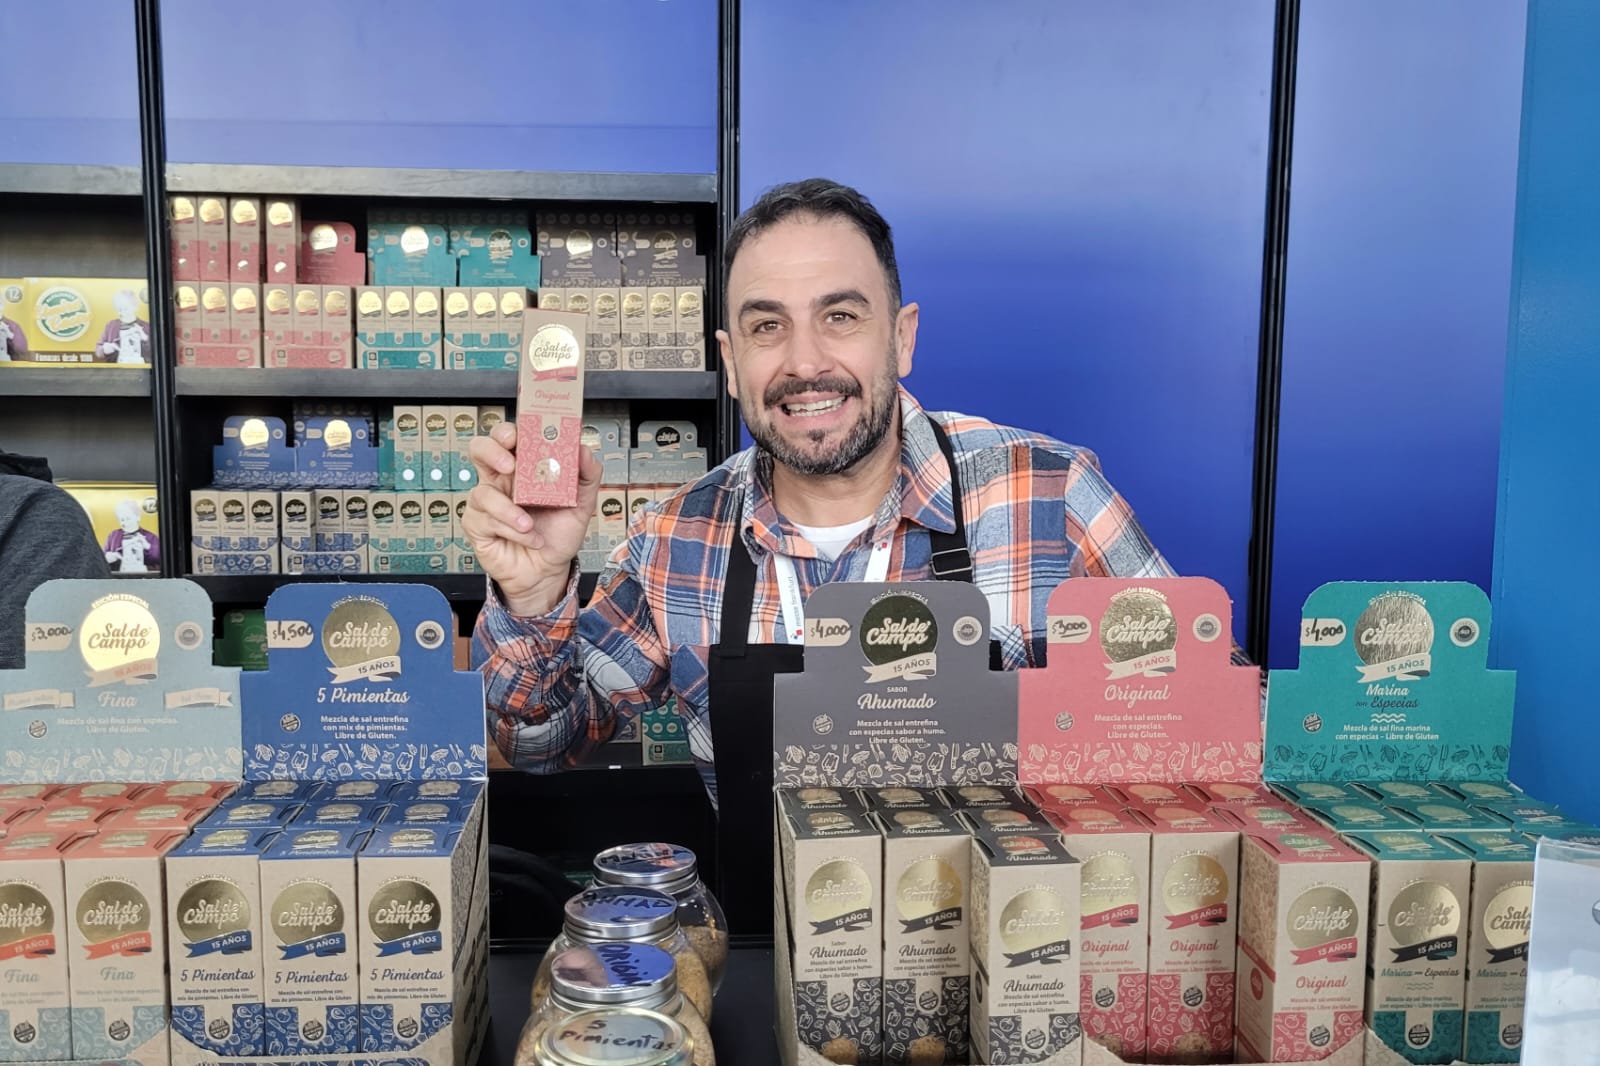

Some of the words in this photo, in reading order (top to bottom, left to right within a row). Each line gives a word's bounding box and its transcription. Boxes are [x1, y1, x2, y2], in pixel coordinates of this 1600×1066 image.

[9, 288, 20, 300] 12
[543, 341, 560, 352] Sal
[561, 343, 573, 352] de
[535, 347, 571, 363] Campo
[1110, 587, 1137, 602] EDICIÓN
[1138, 586, 1169, 602] ESPECIAL
[881, 617, 907, 633] Sal
[907, 617, 929, 632] de
[1121, 615, 1147, 630] Sal
[1147, 615, 1170, 630] de
[1378, 618, 1403, 632] Sal
[103, 623, 129, 638] Sal
[130, 623, 150, 637] de
[344, 622, 368, 638] Sal
[370, 622, 391, 638] de
[1106, 625, 1169, 649] Campo
[88, 633, 149, 656] Campo
[330, 630, 391, 655] Campo
[866, 627, 929, 652] Campo
[1360, 628, 1423, 652] Campo
[358, 666, 367, 674] 15
[368, 659, 395, 672] AÑOS
[894, 664, 902, 672] 15
[904, 658, 931, 670] AÑOS
[1134, 662, 1143, 670] 15
[1144, 656, 1171, 668] AÑOS
[1387, 665, 1396, 673] 15
[1398, 659, 1425, 671] AÑOS
[317, 687, 327, 703] 5
[331, 687, 411, 703] Pimientas
[1104, 684, 1171, 709] Original
[1366, 683, 1409, 697] Marina
[97, 690, 138, 708] Fina
[857, 692, 937, 710] Ahumado
[1371, 696, 1418, 713] Especias
[320, 715, 348, 723] Mezcla
[349, 715, 360, 723] de
[361, 715, 372, 723] sal
[373, 715, 409, 723] entrefina
[857, 719, 882, 727] Mezcla
[883, 719, 893, 727] de
[894, 719, 904, 727] sal
[905, 719, 938, 727] entrefina
[1095, 713, 1121, 721] Mezcla
[1122, 713, 1133, 721] de
[1134, 713, 1146, 721] sal
[1147, 713, 1182, 721] entrefina
[339, 724, 354, 732] mix
[355, 724, 365, 732] de
[366, 724, 408, 734] pimientas.
[863, 729, 894, 737] especias
[895, 728, 916, 736] sabor
[923, 728, 948, 736] humo.
[1107, 731, 1128, 739] Libre
[1129, 731, 1139, 739] de
[1140, 731, 1169, 739] Gluten.
[1344, 724, 1368, 732] Mezcla
[1369, 724, 1379, 732] de
[1380, 724, 1389, 732] sal
[1390, 724, 1405, 732] fina
[1405, 724, 1431, 732] marina
[335, 732, 355, 740] Libre
[357, 732, 367, 740] de
[368, 732, 397, 740] Gluten.
[869, 736, 887, 744] Libre
[888, 736, 898, 744] de
[1350, 734, 1379, 742] especias
[1385, 733, 1404, 741] Libre
[1405, 733, 1414, 741] de
[1415, 733, 1439, 741] Gluten
[812, 828, 861, 836] Ahumado
[1, 903, 24, 918] Sal
[24, 903, 45, 918] de
[97, 900, 120, 916] Sal
[121, 900, 142, 916] de
[198, 899, 220, 912] Sal
[222, 899, 240, 912] de
[293, 902, 316, 916] Sal
[316, 902, 337, 915] de
[388, 900, 412, 914] Sal
[412, 900, 433, 914] de
[84, 909, 142, 930] Campo
[183, 908, 240, 930] Campo
[375, 909, 433, 930] Campo
[845, 912, 869, 924] AÑOS
[935, 911, 958, 923] AÑOS
[1102, 914, 1110, 922] 15
[1111, 908, 1134, 920] AÑOS
[1190, 913, 1199, 921] 15
[1200, 907, 1222, 919] AÑOS
[1307, 906, 1331, 921] Sal
[1331, 906, 1352, 920] de
[1504, 906, 1528, 920] Sal
[278, 911, 337, 932] Campo
[1294, 915, 1351, 936] Campo
[15, 945, 24, 953] 15
[25, 939, 50, 951] AÑOS
[111, 943, 120, 951] 15
[121, 936, 146, 949] AÑOS
[222, 935, 247, 947] AÑOS
[316, 937, 341, 949] AÑOS
[412, 936, 437, 947] AÑOS
[1170, 939, 1219, 957] Original
[1328, 942, 1353, 954] AÑOS
[1427, 941, 1453, 952] AÑOS
[809, 945, 868, 959] Ahumado
[899, 944, 956, 957] Ahumado
[1031, 951, 1039, 959] 15
[1041, 944, 1065, 956] AÑOS
[1081, 939, 1130, 958] Original
[1513, 947, 1522, 955] 15
[4, 968, 40, 983] Fina
[100, 966, 136, 981] Fina
[181, 970, 189, 982] 5
[192, 968, 257, 982] Pimientas
[275, 971, 283, 984] 5
[286, 970, 350, 984] Pimientas
[370, 969, 378, 981] 5
[382, 968, 445, 981] Pimientas
[1381, 968, 1414, 977] Marina
[1424, 967, 1461, 979] Especias
[1003, 978, 1066, 992] Ahumado
[1296, 975, 1349, 994] Original
[587, 1019, 607, 1030] 5
[559, 1031, 676, 1051] Pimientas
